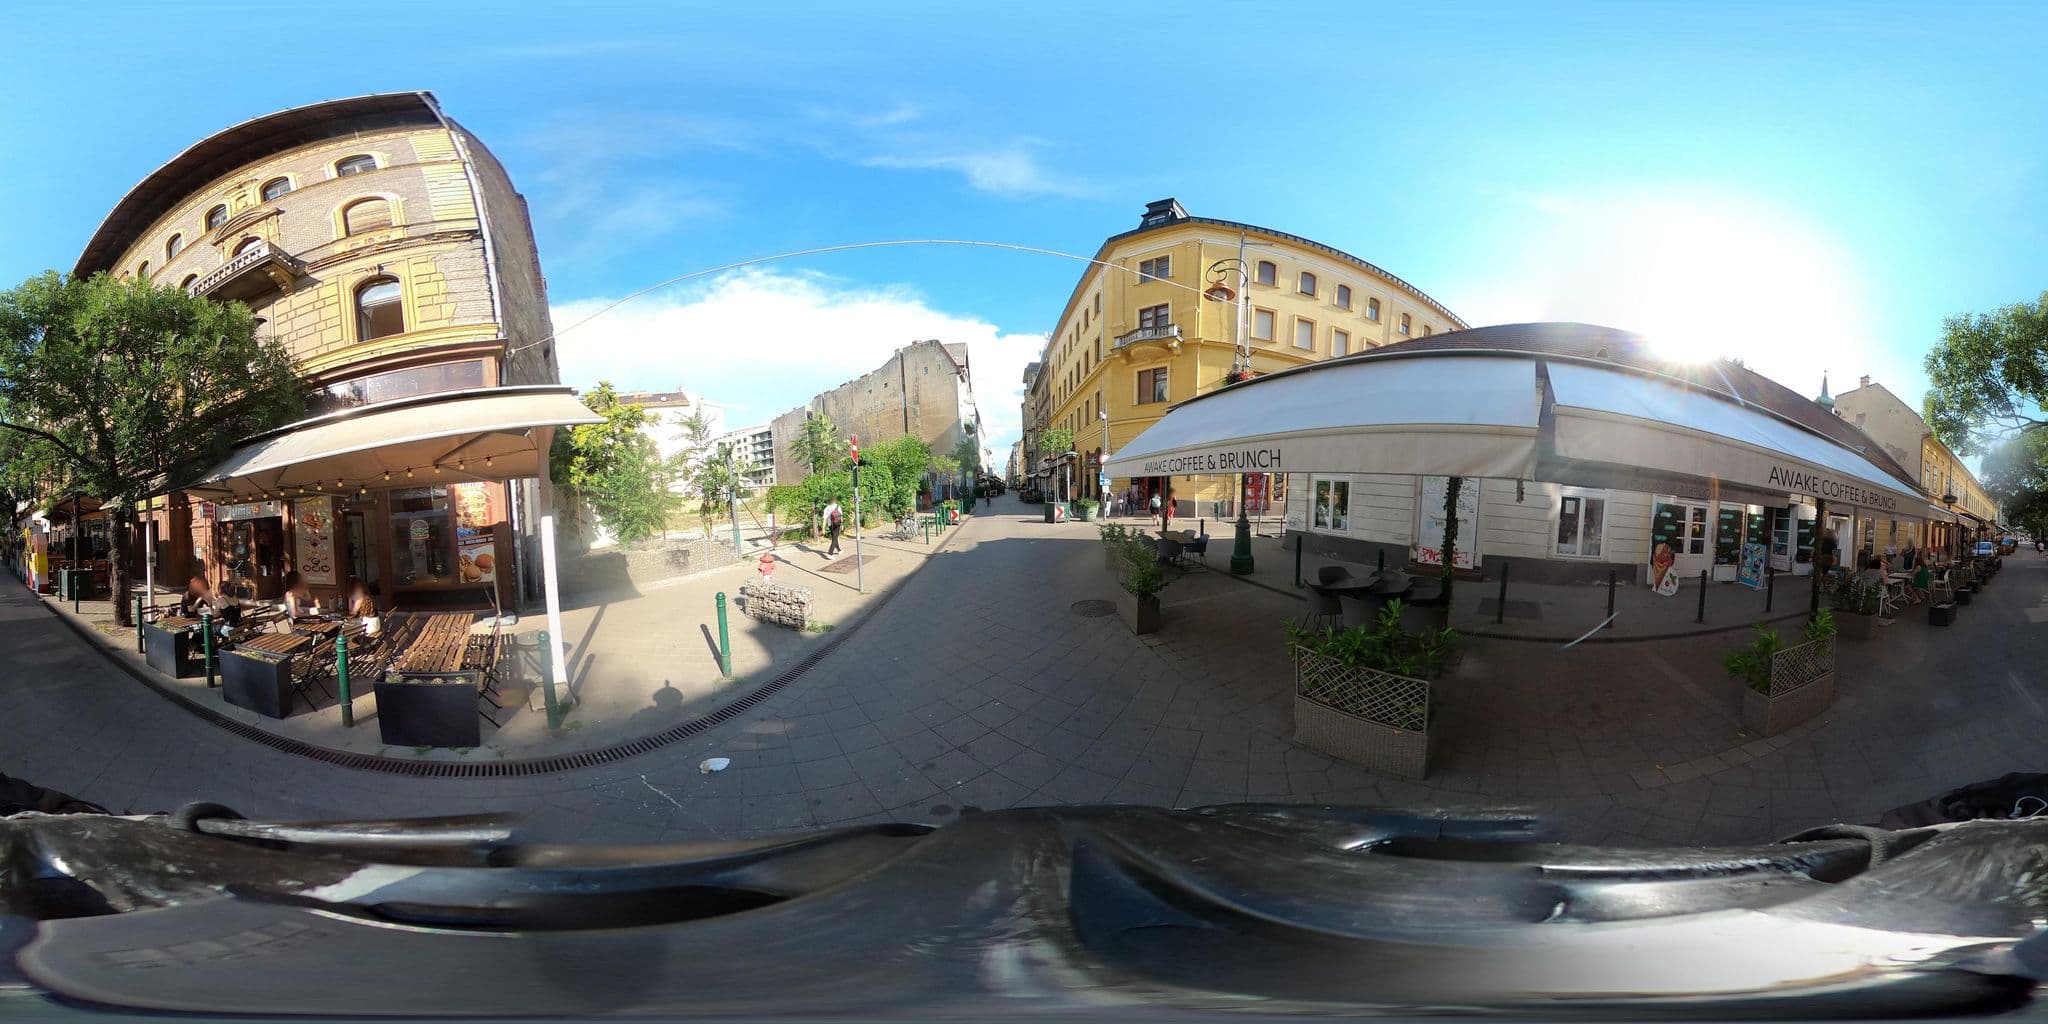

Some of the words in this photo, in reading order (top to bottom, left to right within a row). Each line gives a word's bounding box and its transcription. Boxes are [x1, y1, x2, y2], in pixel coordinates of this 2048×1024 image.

[1144, 459, 1167, 473] AWAKE
[1168, 455, 1204, 472] COFFEE
[1207, 454, 1216, 470] &
[1220, 449, 1281, 469] BRUNCH
[1768, 466, 1819, 493] AWAKE
[1822, 479, 1860, 502] COFFEE
[1861, 490, 1868, 504] &
[1869, 492, 1897, 510] BRUNCH
